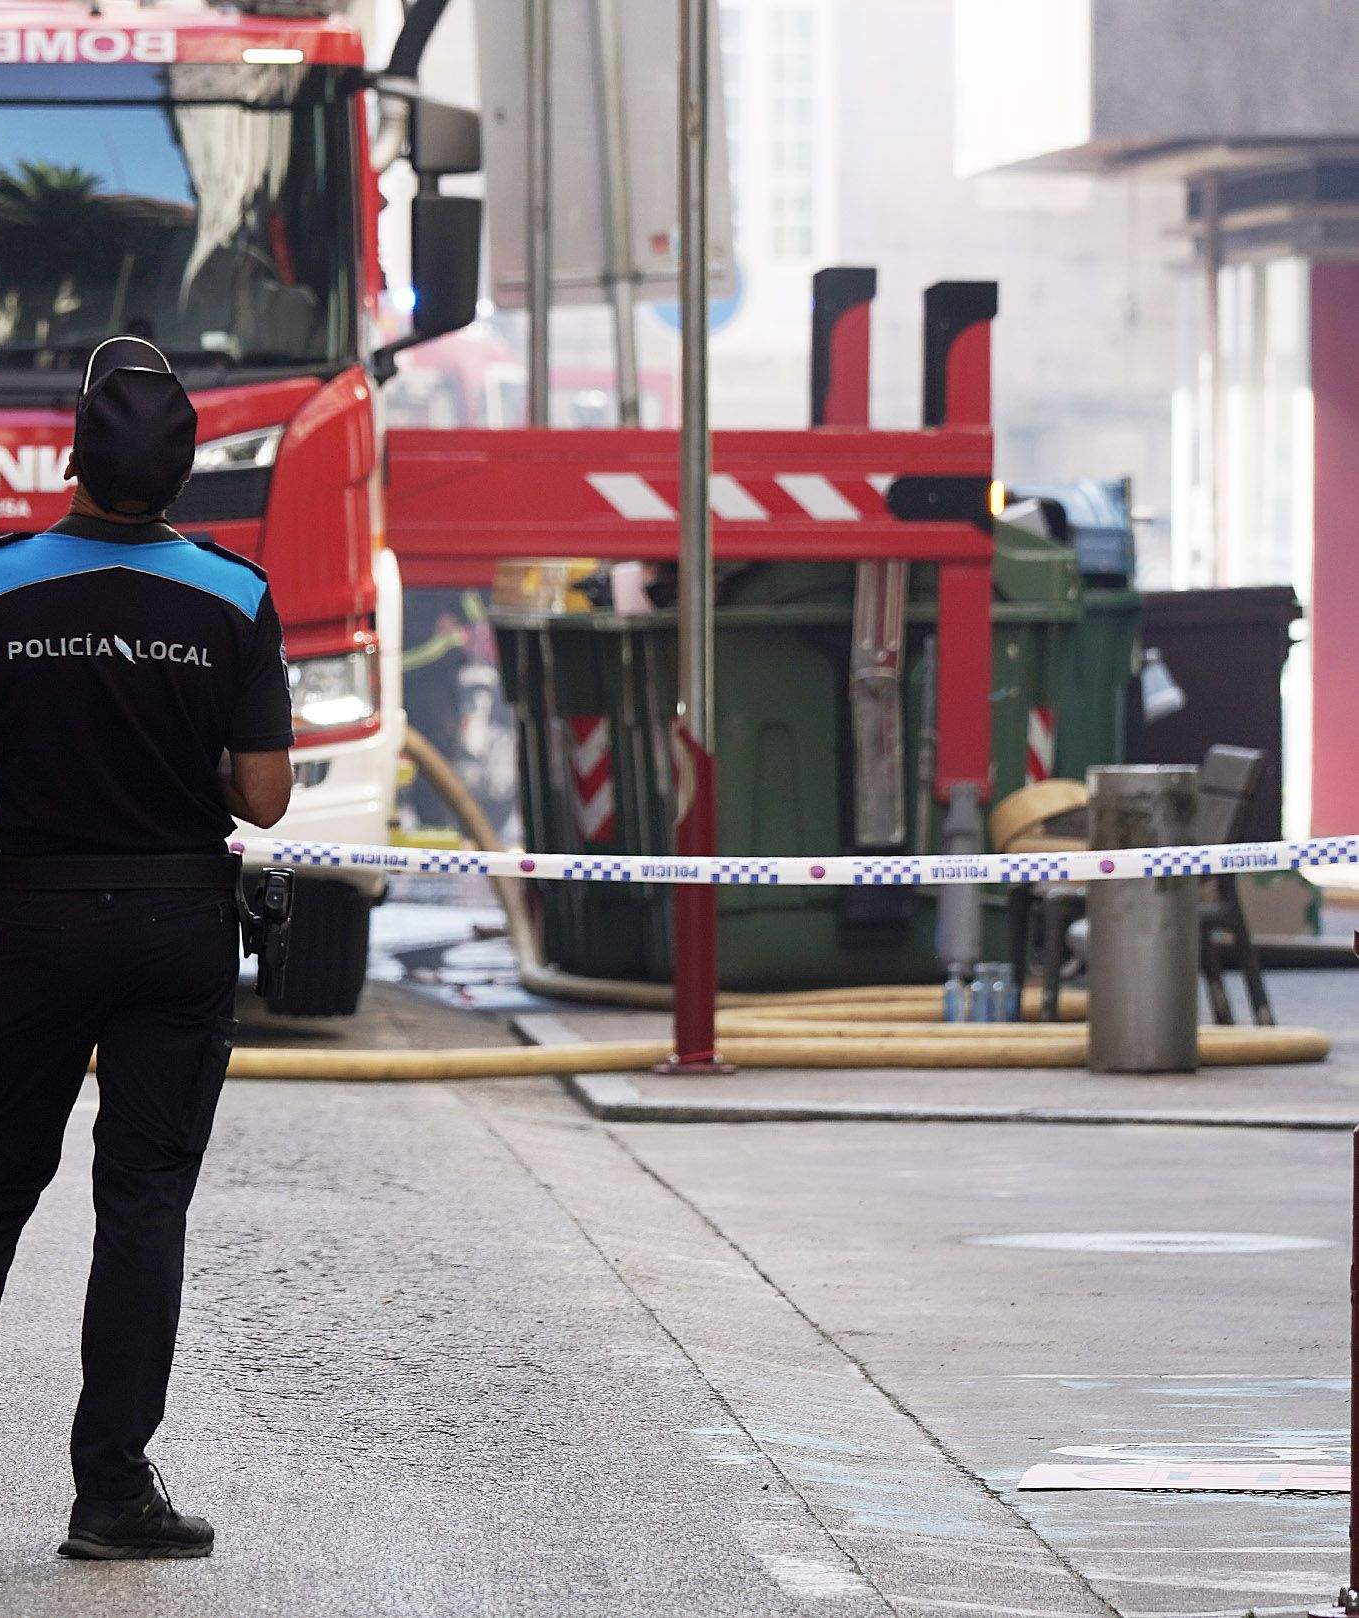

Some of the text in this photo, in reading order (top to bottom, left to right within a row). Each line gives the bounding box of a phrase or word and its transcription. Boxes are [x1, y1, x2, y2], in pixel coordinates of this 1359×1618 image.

[8, 633, 212, 667] POLICÍA LOCAL
[351, 851, 408, 867] POLICIA
[1221, 853, 1277, 870] POLICIA
[642, 864, 698, 879] POLICIA
[930, 865, 988, 880] POLICIA
